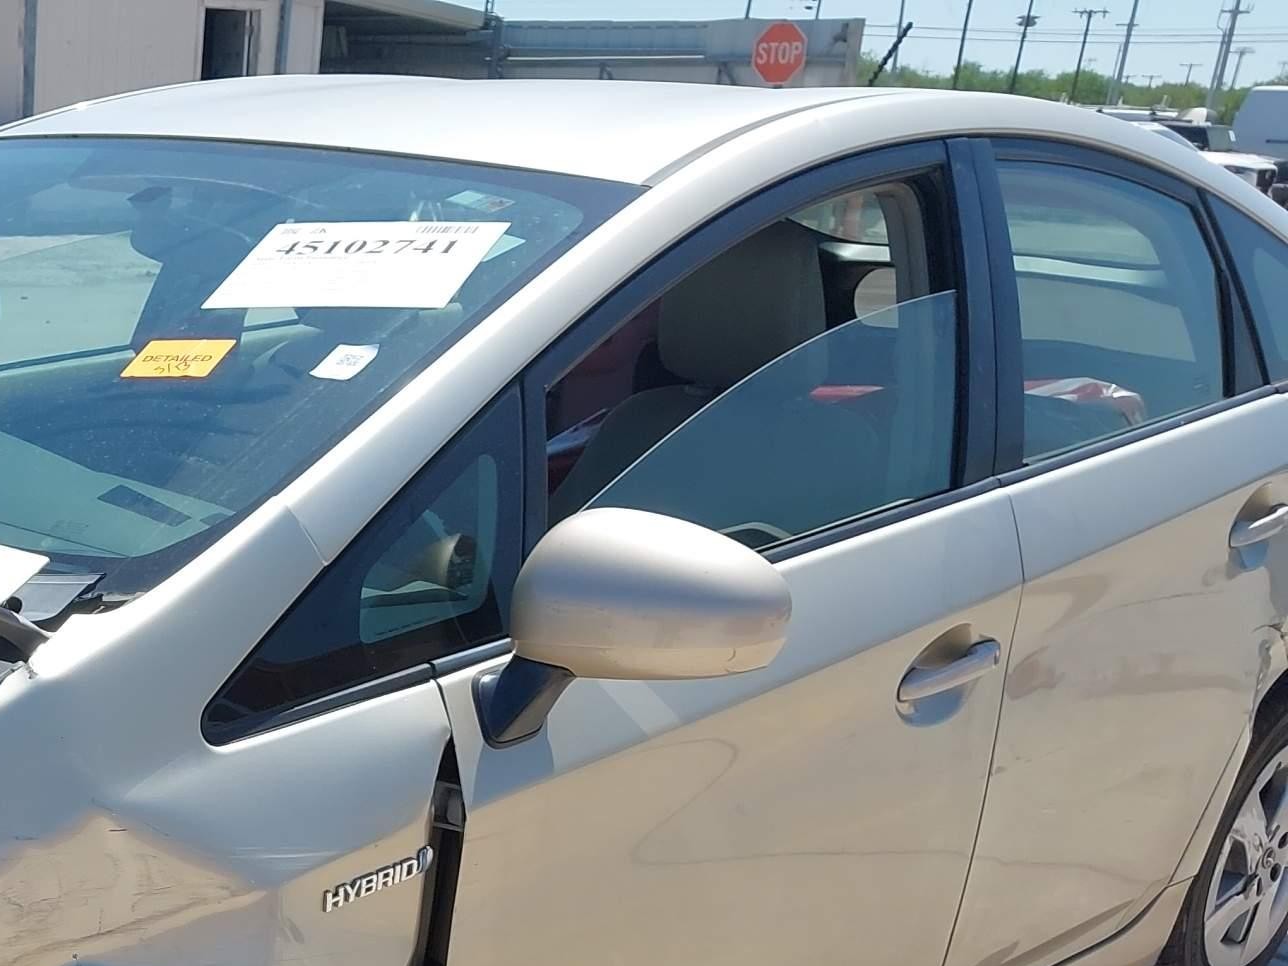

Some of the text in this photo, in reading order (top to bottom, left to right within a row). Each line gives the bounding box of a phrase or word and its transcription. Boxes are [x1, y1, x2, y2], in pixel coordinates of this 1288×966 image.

[757, 42, 802, 64] STOP
[276, 239, 458, 255] 45102741
[142, 354, 213, 363] DETAILED
[323, 857, 418, 912] HYBRID
